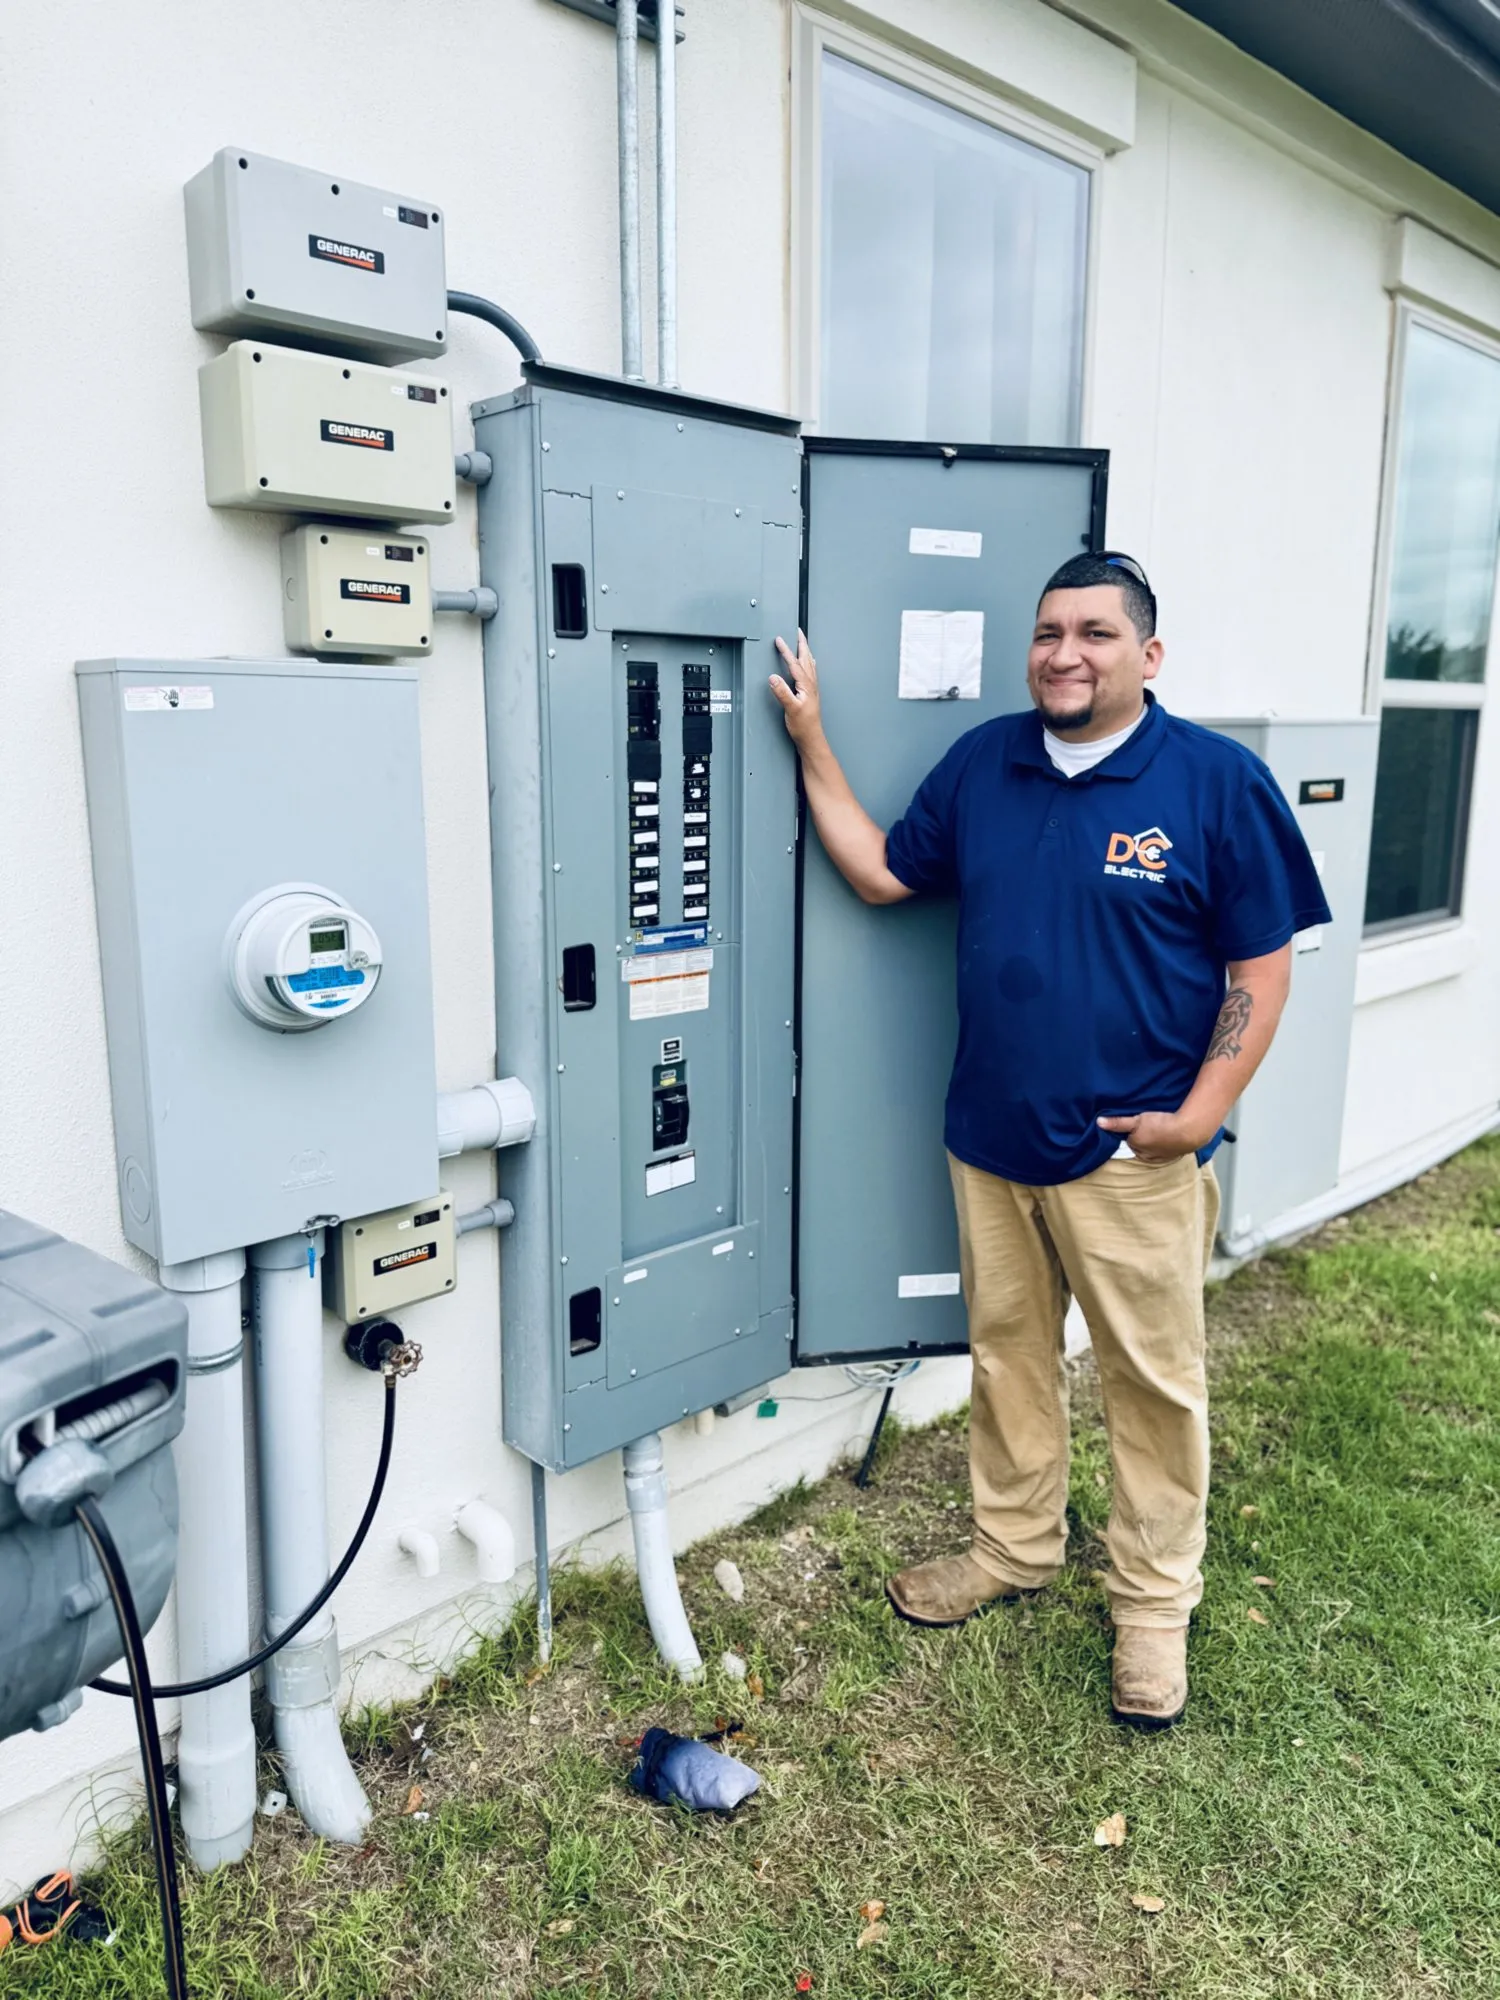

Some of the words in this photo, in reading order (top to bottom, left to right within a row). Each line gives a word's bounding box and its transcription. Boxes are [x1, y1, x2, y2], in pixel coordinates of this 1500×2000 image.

[316, 239, 375, 263] GENERAC
[328, 423, 385, 441] GENERAC
[347, 581, 402, 595] GENERAC
[1106, 832, 1169, 870] DC
[1103, 864, 1167, 883] ELECTRIC
[380, 1245, 430, 1267] GENERAC
